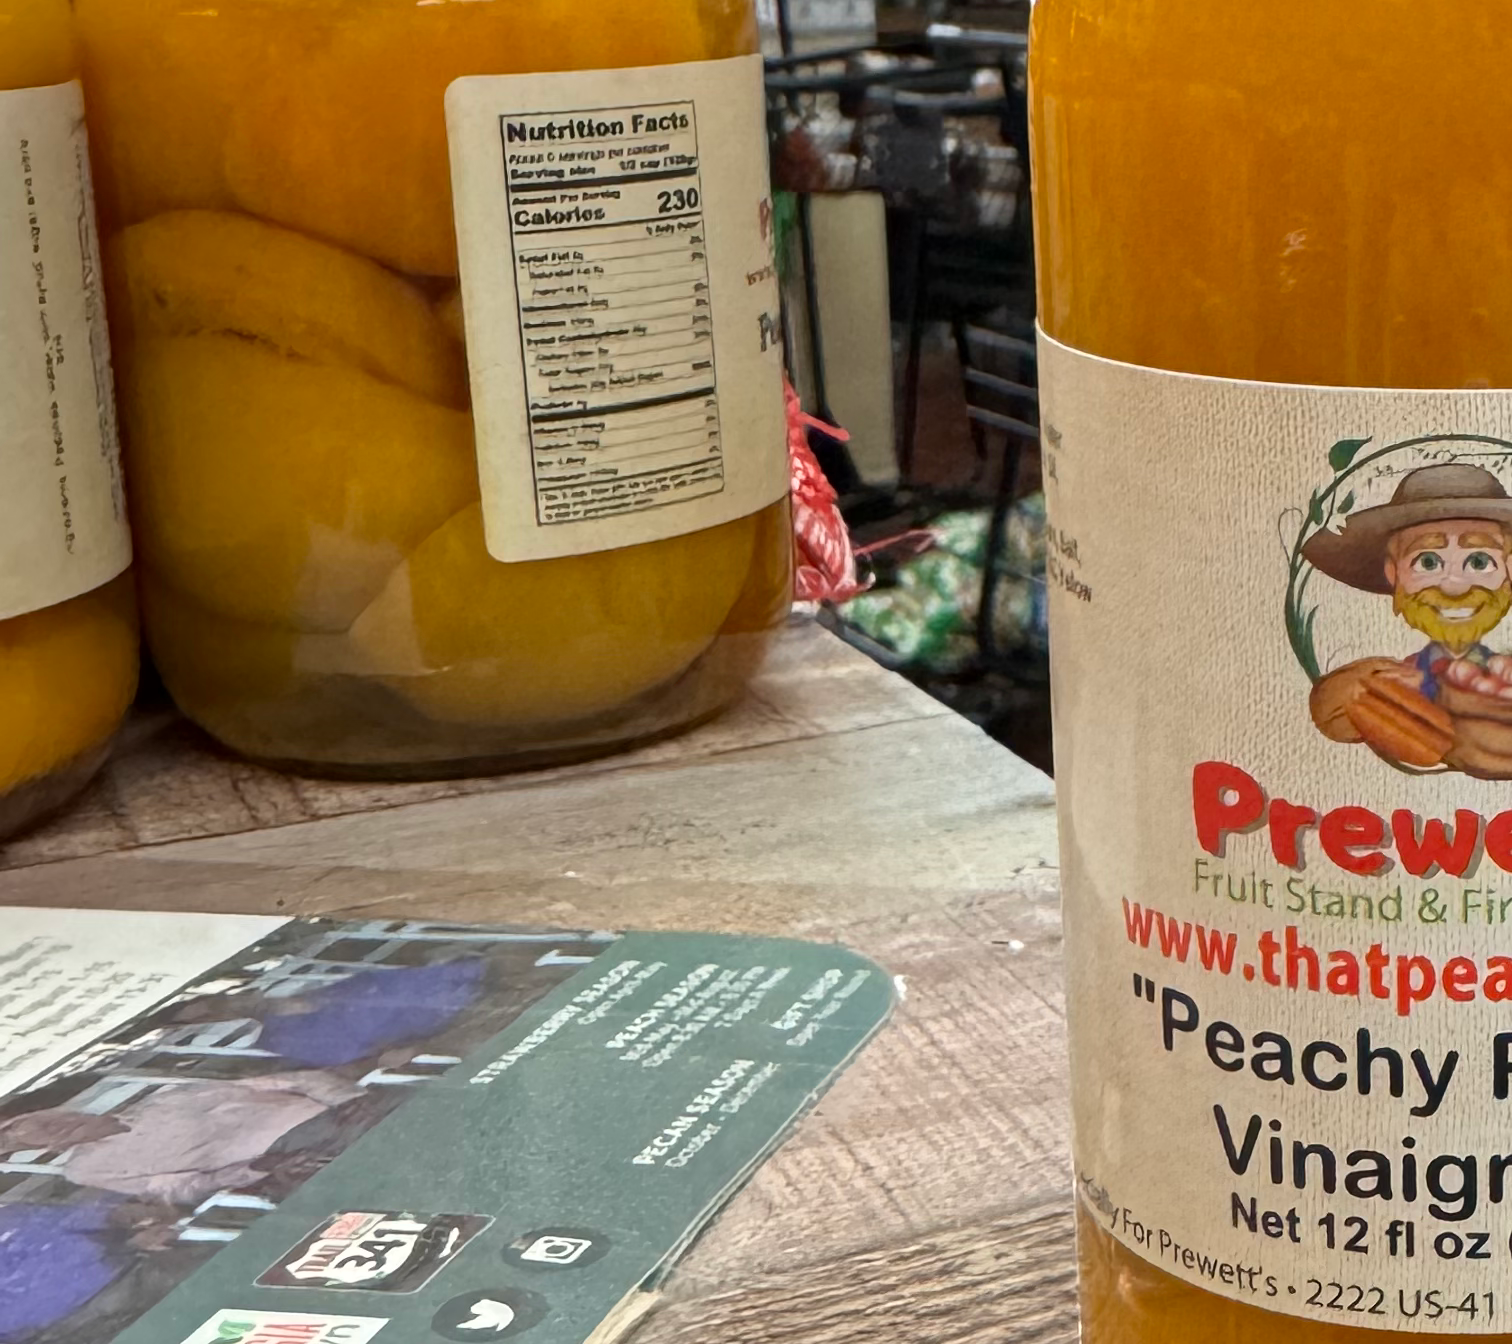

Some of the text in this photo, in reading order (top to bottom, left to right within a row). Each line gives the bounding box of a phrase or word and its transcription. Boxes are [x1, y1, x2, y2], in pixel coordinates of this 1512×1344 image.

[507, 111, 689, 143] Nutrition Facts
[514, 187, 699, 227] Calories 230
[1194, 858, 1278, 912] Fruit
[1285, 876, 1403, 925] Stand
[1417, 888, 1448, 924] &
[1132, 973, 1460, 1117] "Peachy
[632, 1059, 755, 1165] PECAN SEASON
[334, 1228, 421, 1272] 341
[1230, 1192, 1302, 1244] Net
[1317, 1212, 1369, 1256] 12
[1385, 1215, 1416, 1259] fl
[1434, 1228, 1492, 1260] oz
[1123, 1206, 1153, 1250] For
[1159, 1227, 1278, 1297] Prewett's
[1304, 1276, 1386, 1317] 2222
[1397, 1289, 1497, 1321] US-41
